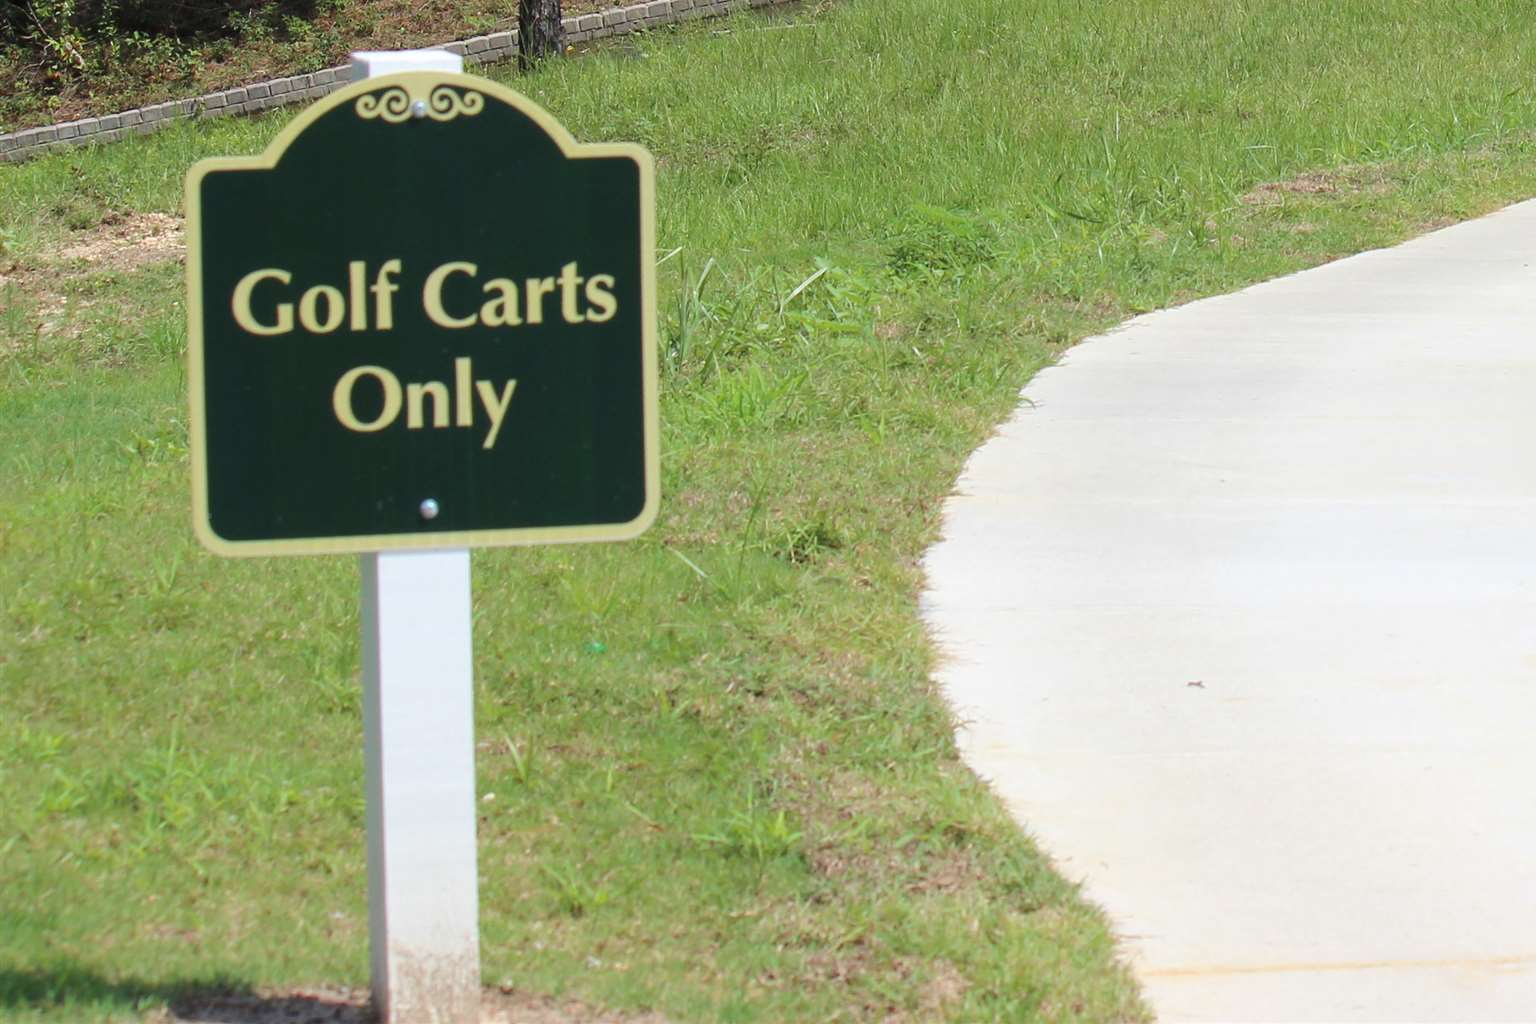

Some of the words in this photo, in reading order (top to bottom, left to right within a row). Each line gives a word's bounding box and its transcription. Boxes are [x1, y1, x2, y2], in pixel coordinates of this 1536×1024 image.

[231, 259, 401, 335] Golf
[423, 261, 617, 329] Carts
[332, 357, 517, 449] Only
